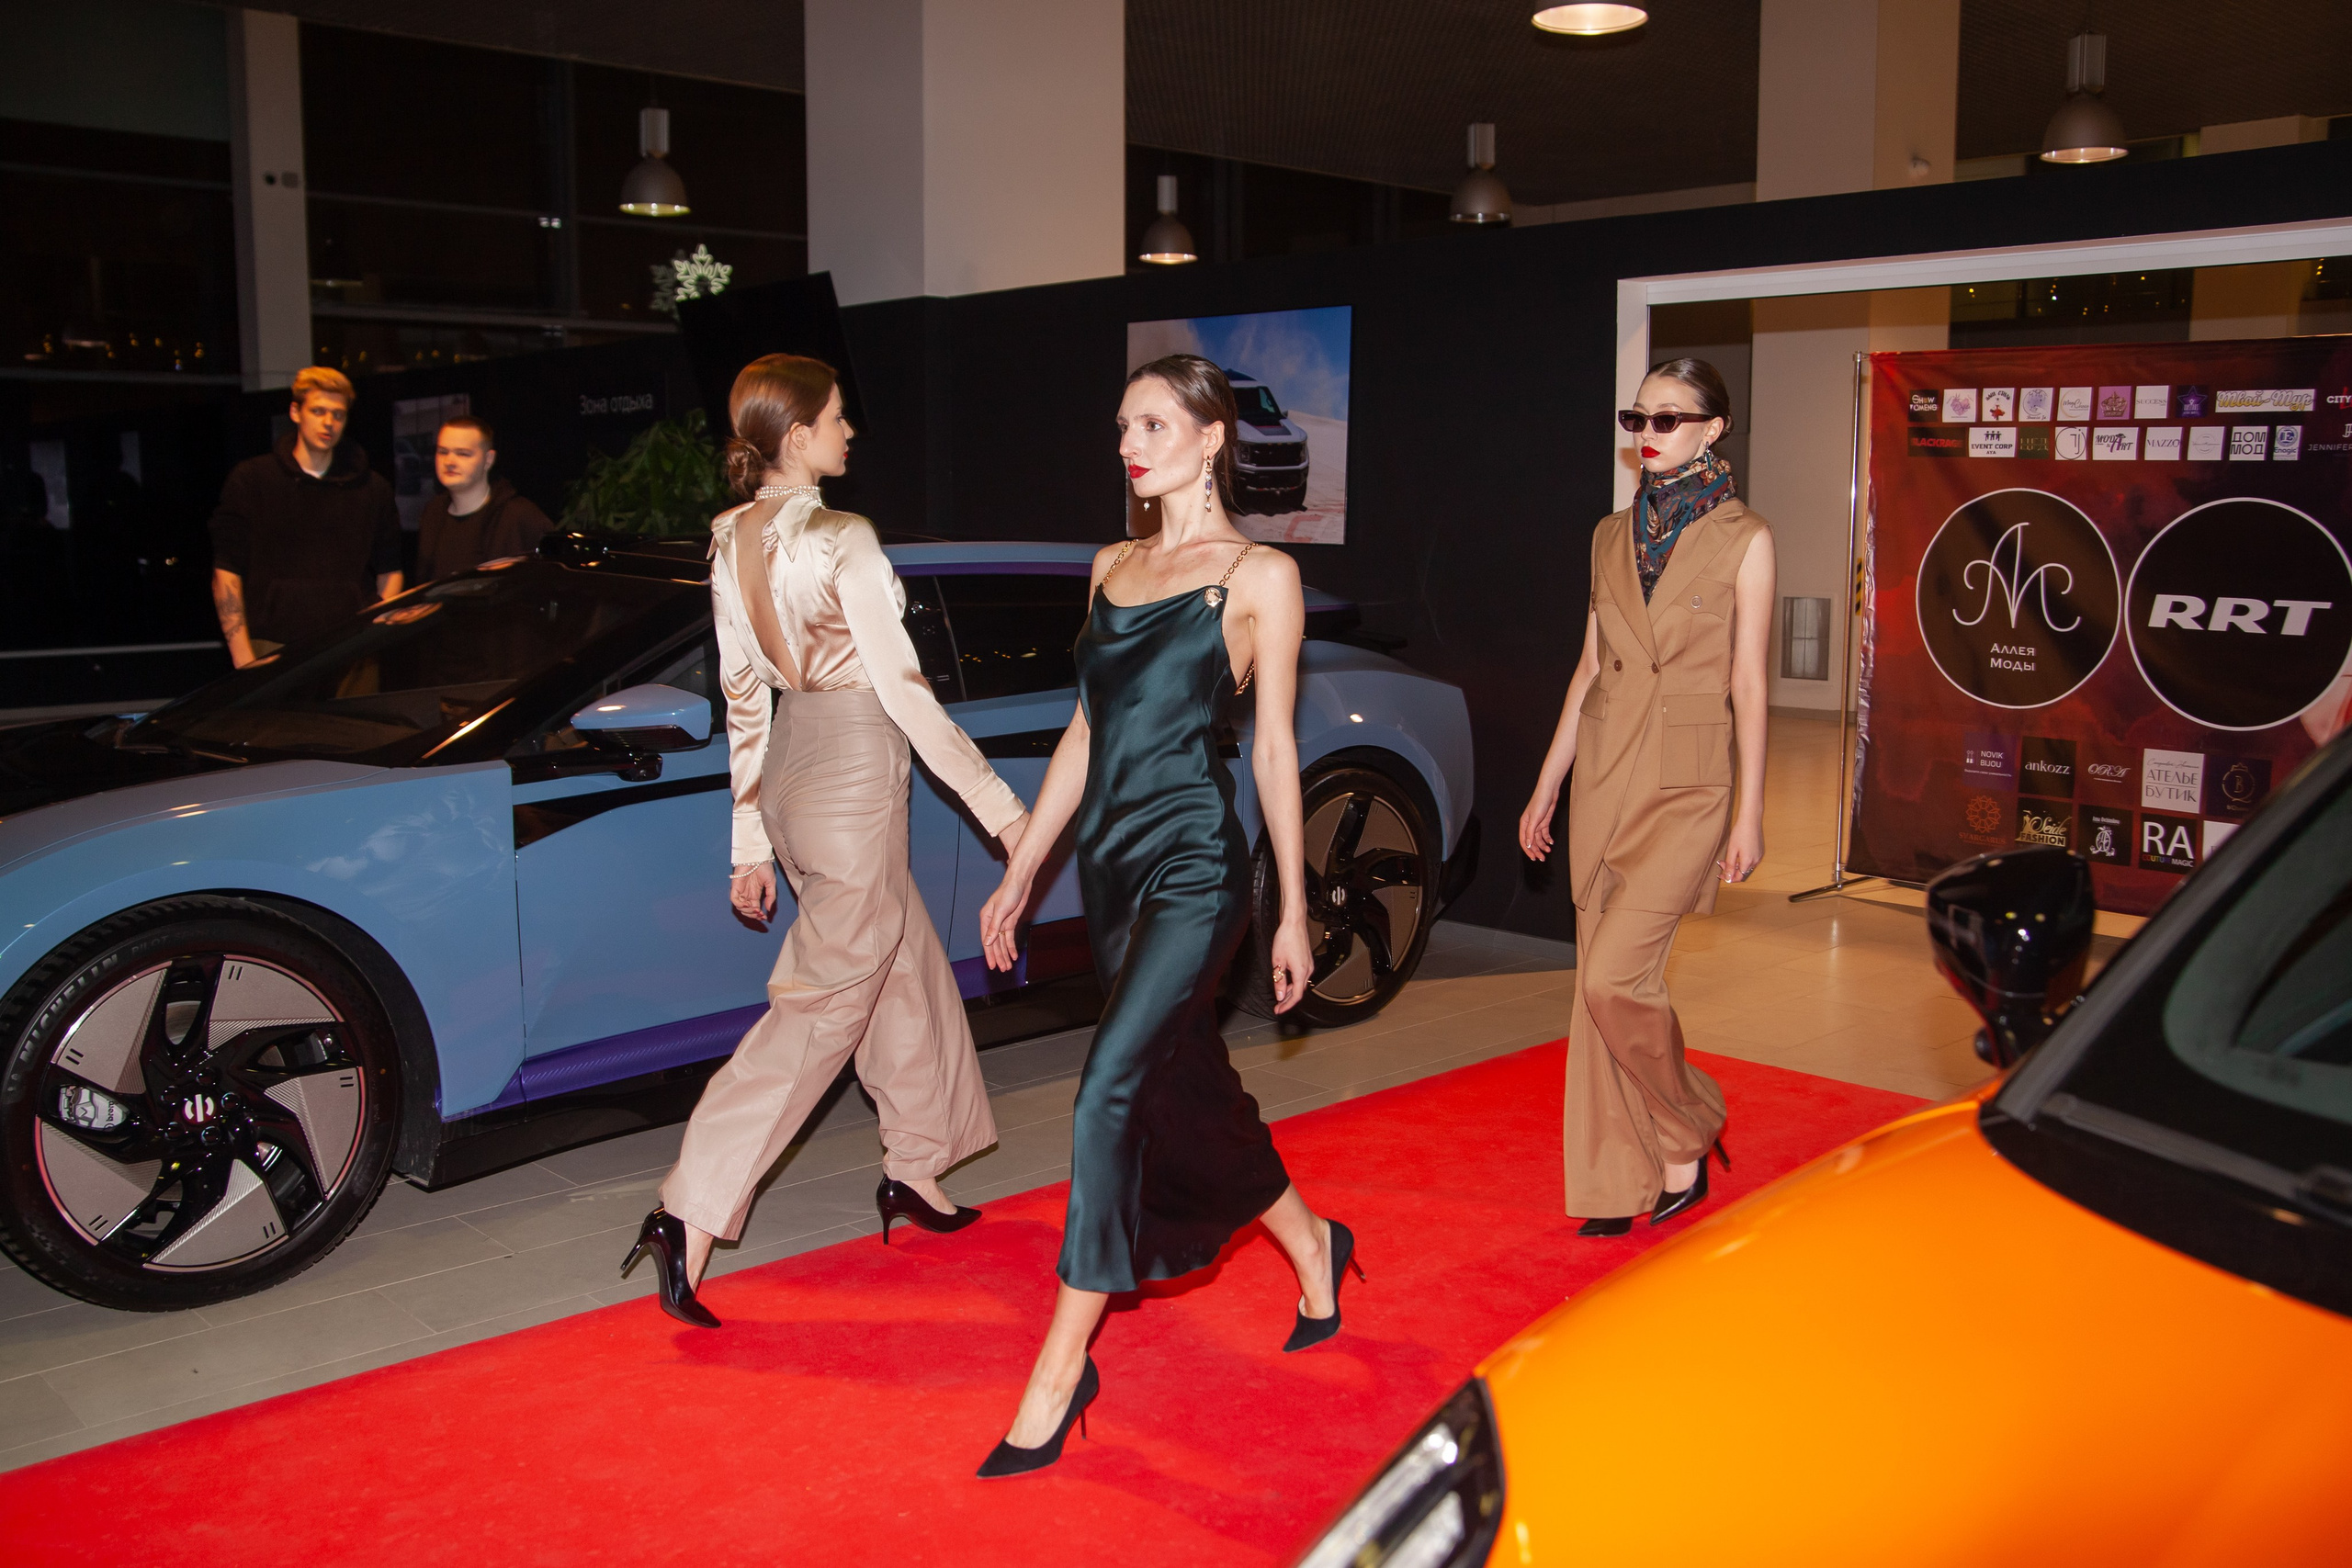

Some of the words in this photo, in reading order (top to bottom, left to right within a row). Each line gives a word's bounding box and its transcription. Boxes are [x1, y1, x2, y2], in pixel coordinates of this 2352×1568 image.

[579, 394, 608, 415] Зона
[610, 393, 653, 415] отдыха
[2326, 395, 2352, 404] CITY
[2147, 439, 2180, 448] MAZZO
[2147, 593, 2332, 637] RRT
[1980, 750, 2004, 760] NOVIK
[1980, 759, 2002, 768] BIJOU
[2025, 760, 2071, 775] ankozz
[2146, 769, 2199, 785] АТЕЛЬЕ
[2145, 784, 2197, 803] БУТИК
[2020, 833, 2065, 845] FASHION
[2143, 821, 2195, 859] RA
[19, 953, 119, 1064] MICHELIN
[106, 1099, 114, 1122] brem
